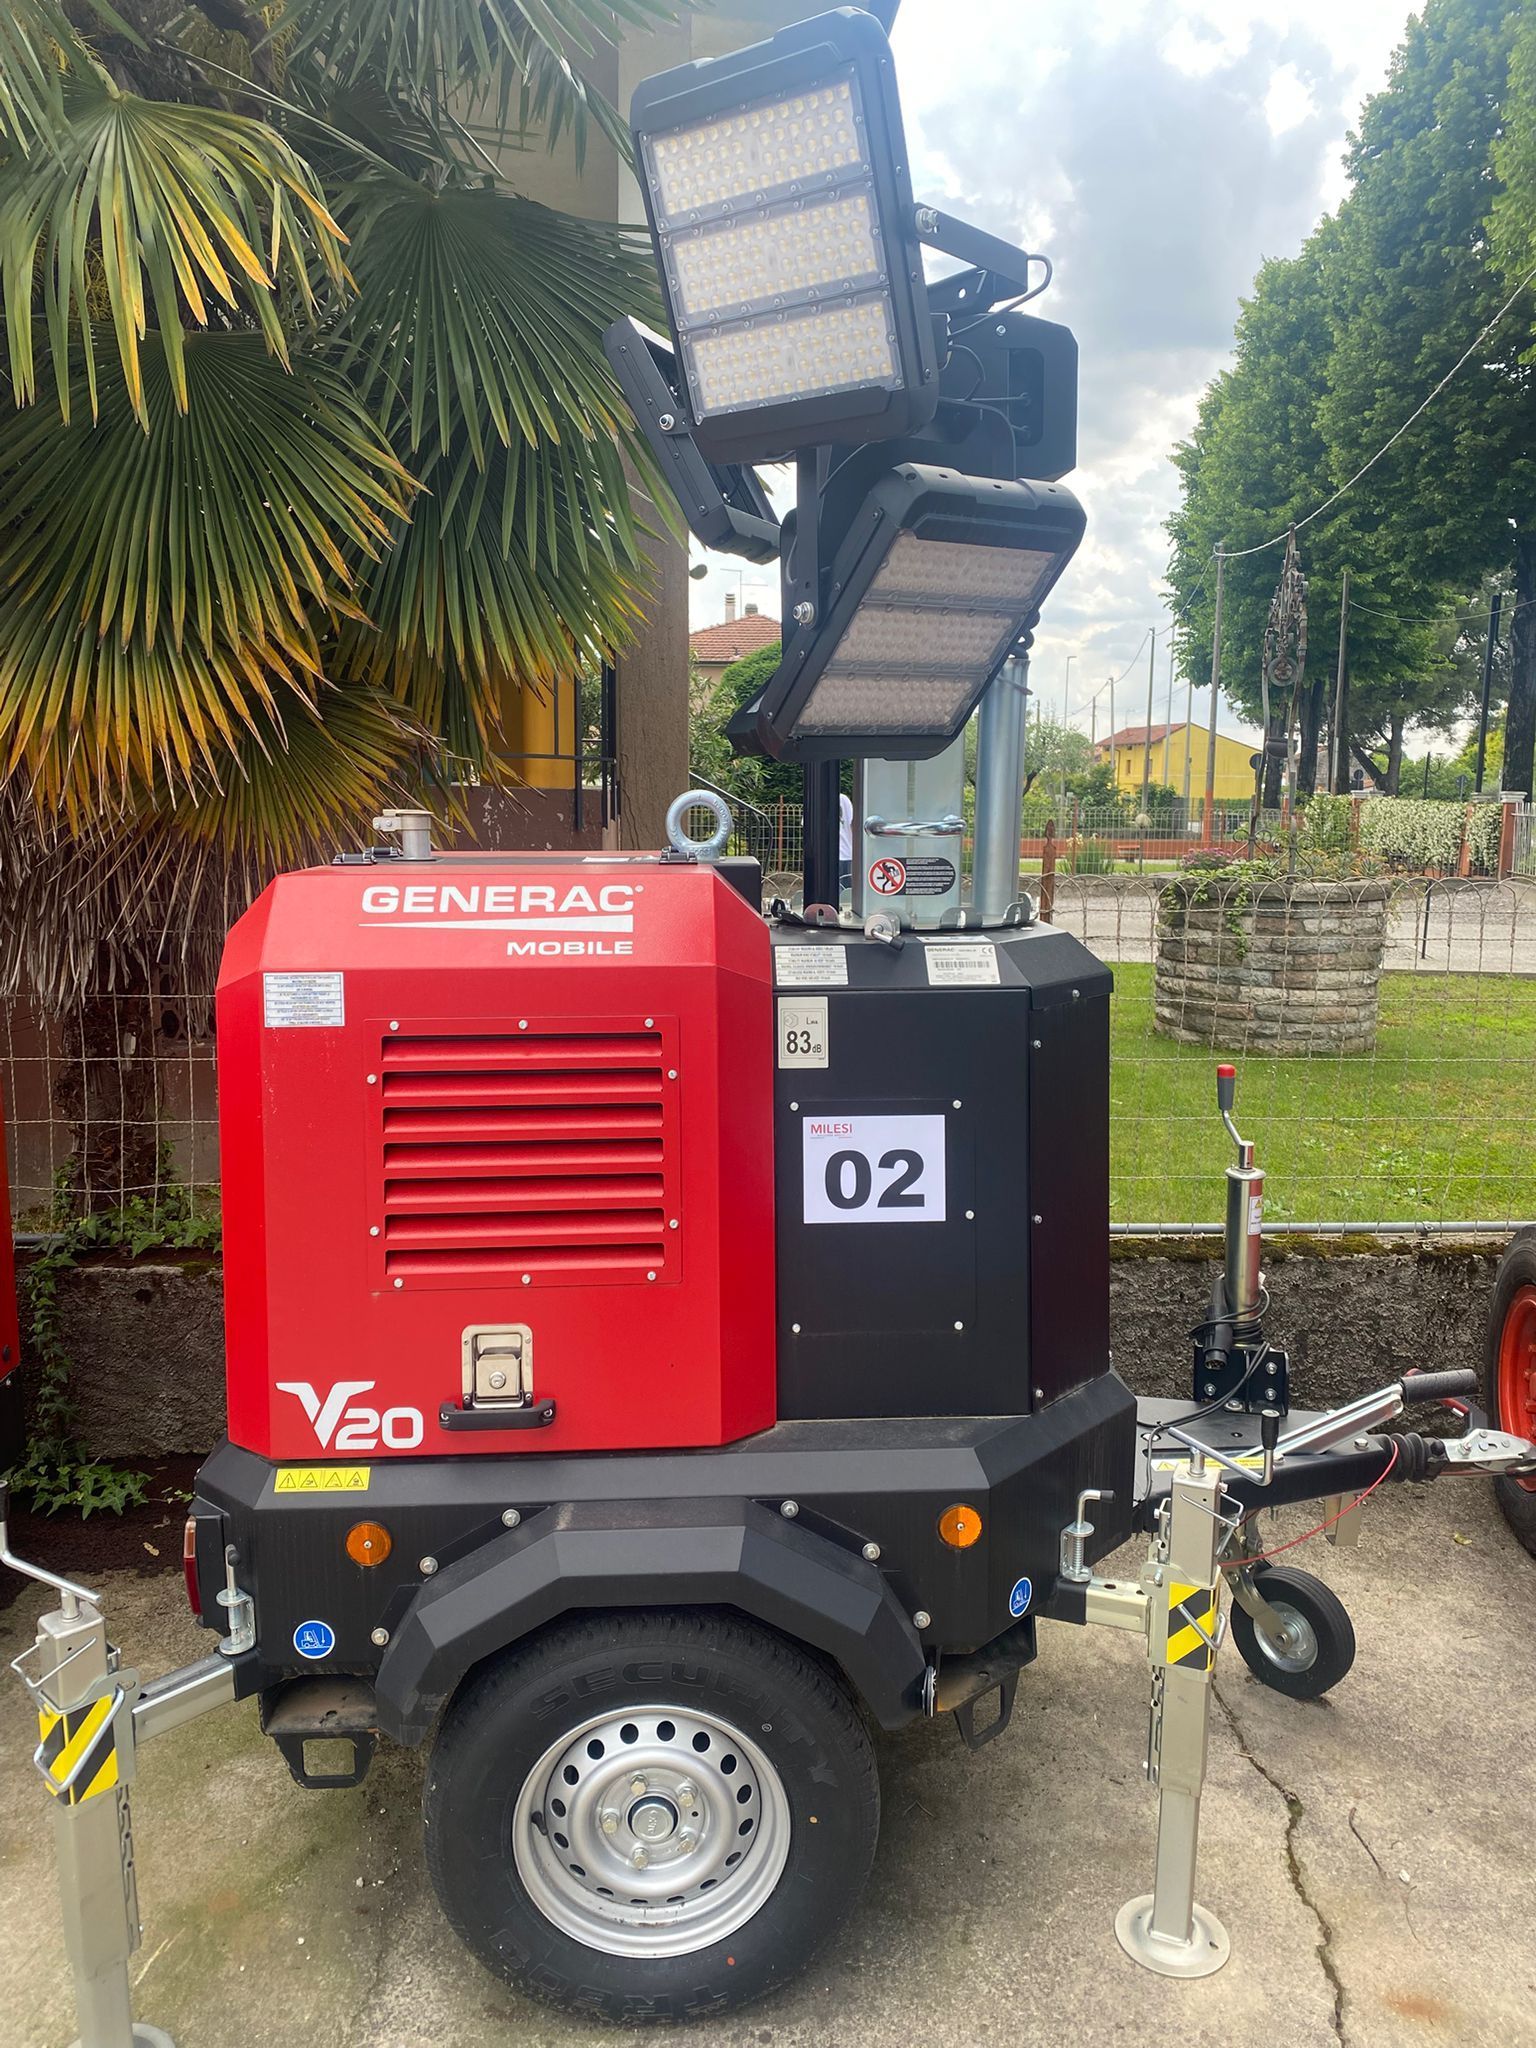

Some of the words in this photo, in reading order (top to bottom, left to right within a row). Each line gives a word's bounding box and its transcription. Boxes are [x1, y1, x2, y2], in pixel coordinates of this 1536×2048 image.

[361, 885, 635, 914] GENERAC
[506, 941, 634, 956] MOBILE
[810, 1123, 853, 1135] MILESI
[824, 1148, 926, 1210] 02
[275, 1380, 424, 1451] V20
